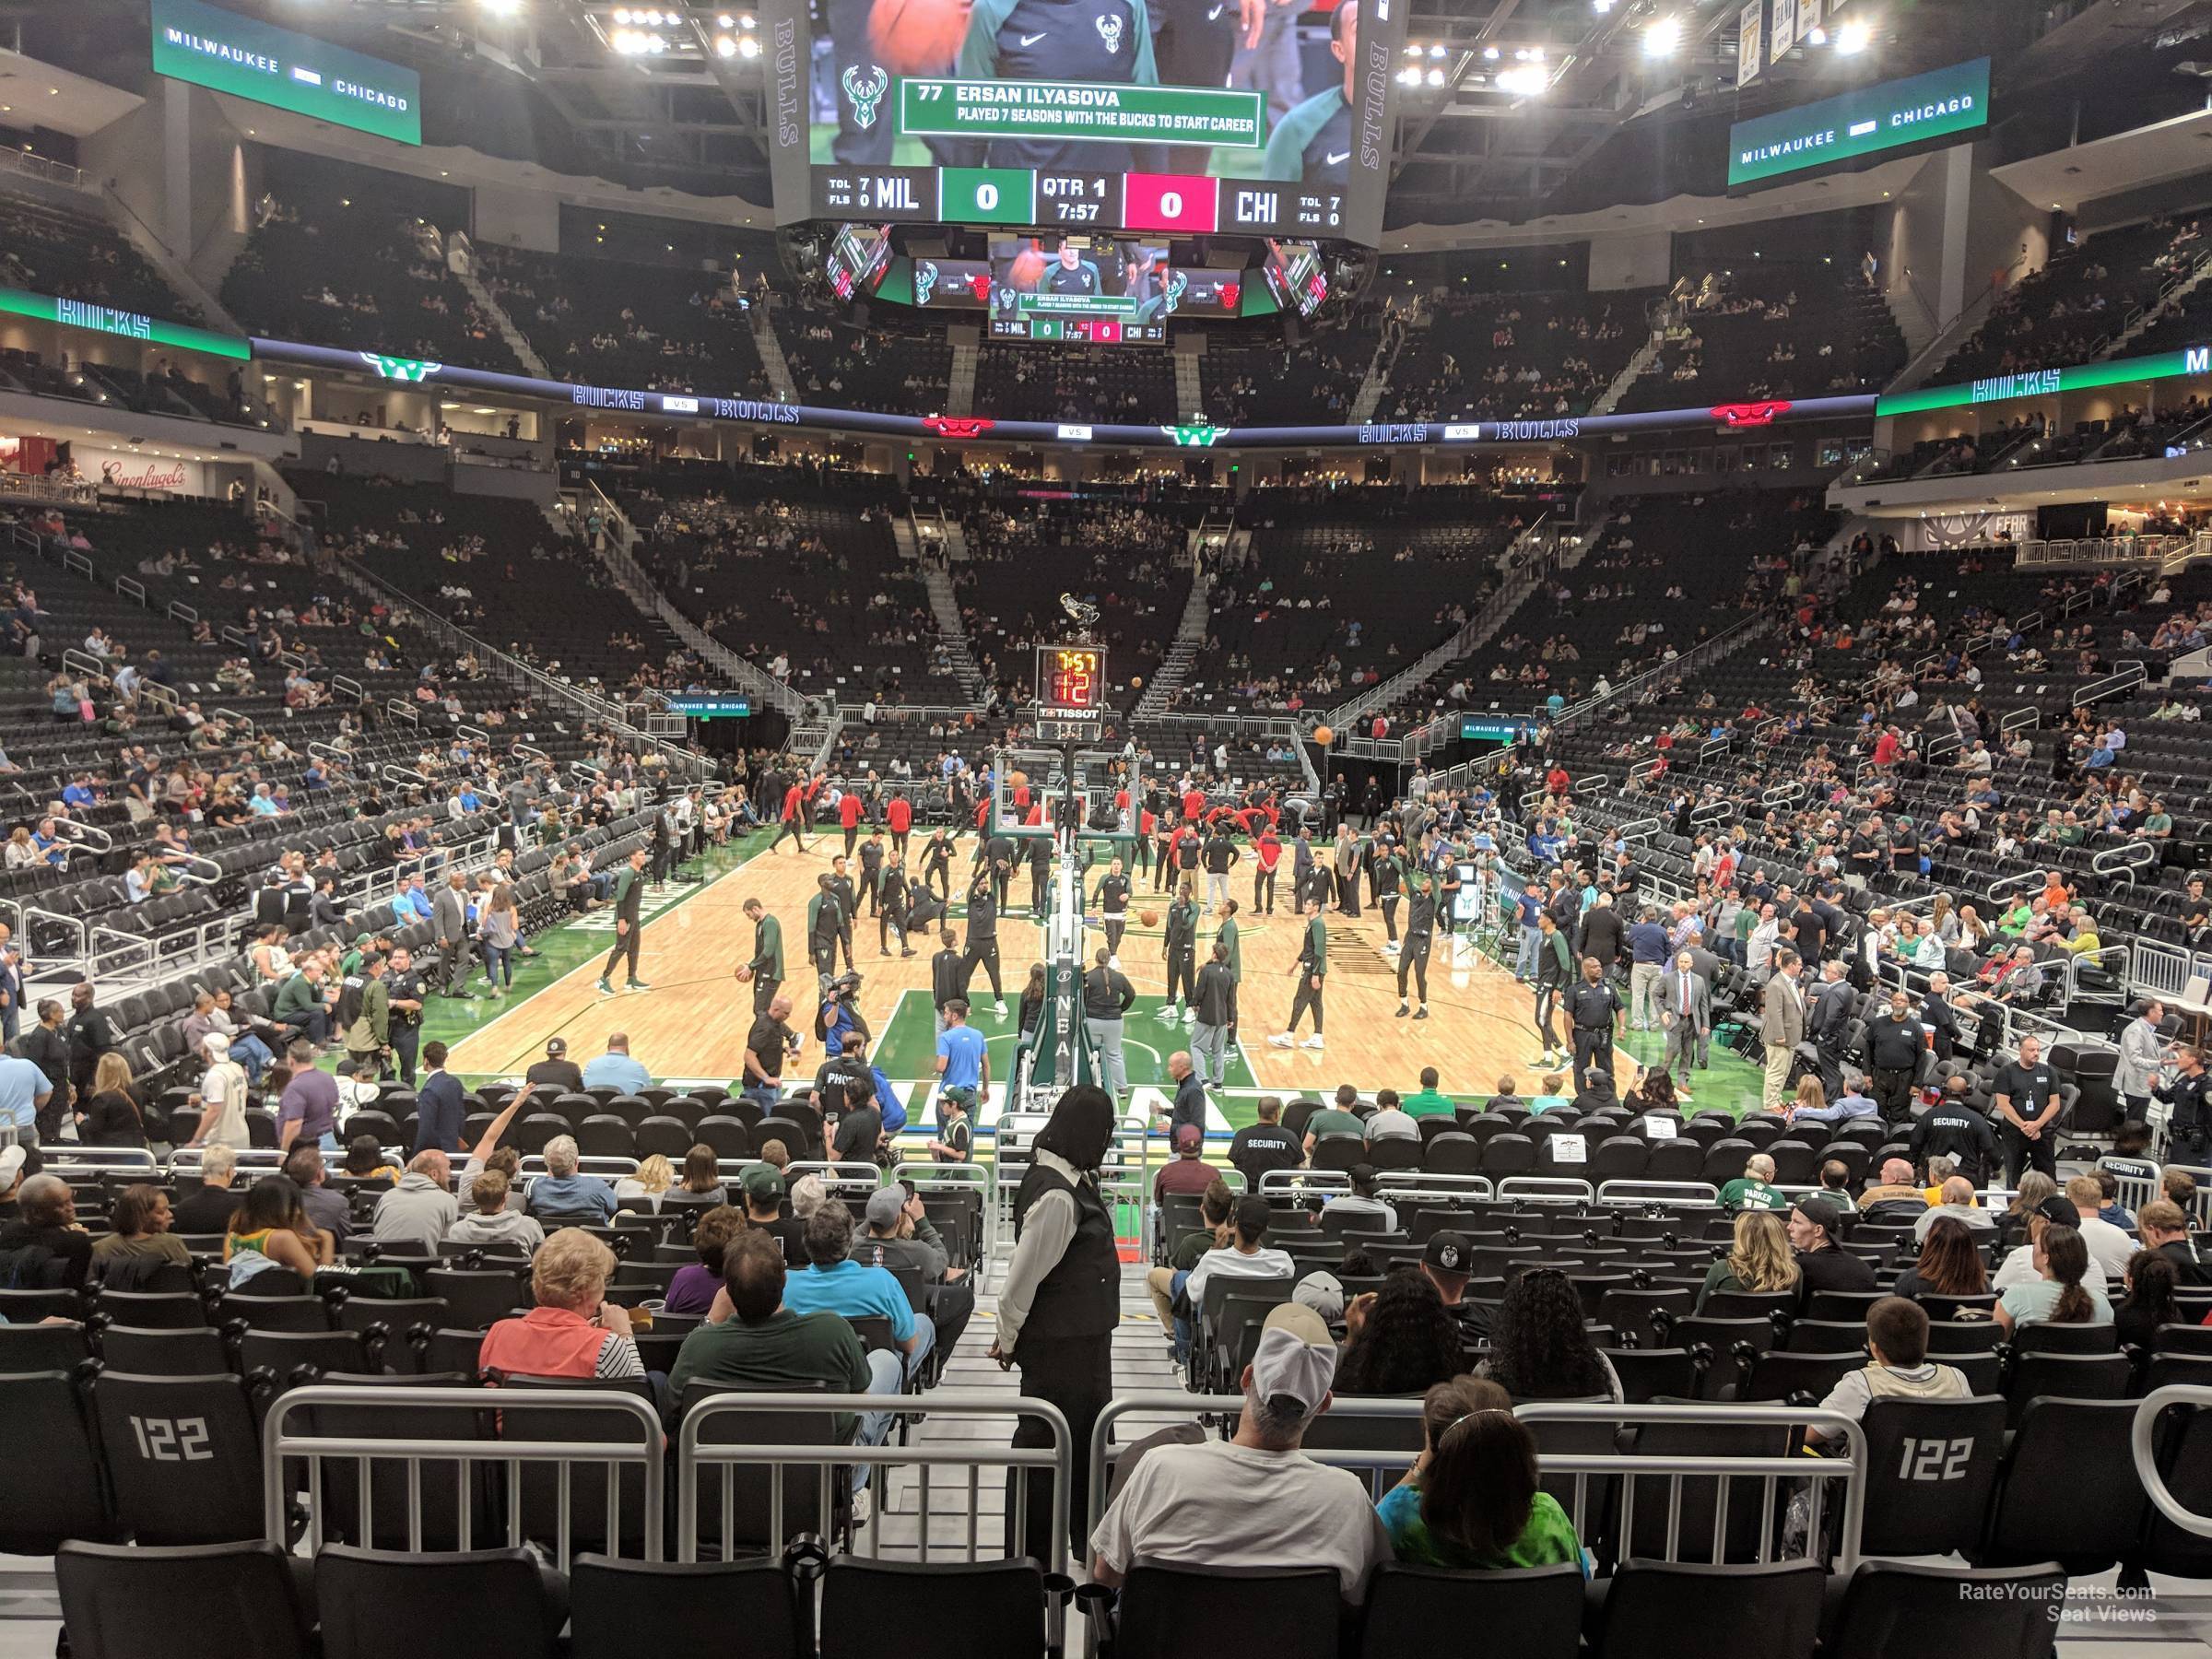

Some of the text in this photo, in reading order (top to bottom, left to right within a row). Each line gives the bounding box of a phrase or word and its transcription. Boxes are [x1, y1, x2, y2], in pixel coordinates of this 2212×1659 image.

[168, 29, 407, 112] MILWAUKEE CHICAGO
[774, 18, 798, 147] BULLS
[918, 85, 1120, 107] 77 ERSAN ILYASOVA
[1360, 41, 1389, 170] BULLS
[958, 107, 1254, 133] PLAYED 7 SEASONS WITH THE BUCKS TO START CAREER
[1741, 96, 1972, 163] MILWAUKEE CHICAGO
[830, 178, 870, 191] TOL 7
[877, 178, 920, 209] MIL
[1042, 178, 1106, 197] QTR 1
[830, 194, 870, 206] FLS 0
[976, 183, 999, 210] 0
[1160, 192, 1182, 218] 0
[1300, 196, 1341, 210] TOL 7
[1057, 203, 1100, 221] 7:57
[1237, 192, 1277, 223] CHI
[1300, 213, 1340, 226] FLS 0
[1011, 324, 1025, 334] MIL
[1043, 324, 1052, 335] 0
[1066, 331, 1083, 339] 7:57
[1102, 326, 1111, 338] 0
[1127, 327, 1141, 338] CHI
[572, 383, 799, 424] BUCKS VS BULLS
[1359, 423, 1427, 443] BUCKS
[1496, 418, 1579, 441] BULLS
[1995, 514, 2028, 532] FEAR
[1059, 653, 1095, 672] 7:57
[1062, 672, 1089, 703] 12
[1056, 709, 1099, 719] TISSOT
[1055, 995, 1071, 1056] NBA
[827, 1072, 855, 1085] PHO
[1933, 1117, 1970, 1129] SECURITY
[1247, 1139, 1287, 1150] SECURITY
[2105, 1161, 2146, 1176] SECURITY
[1744, 1187, 1773, 1203] PARKER
[129, 1416, 214, 1460] 122
[1899, 1437, 1974, 1481] 122
